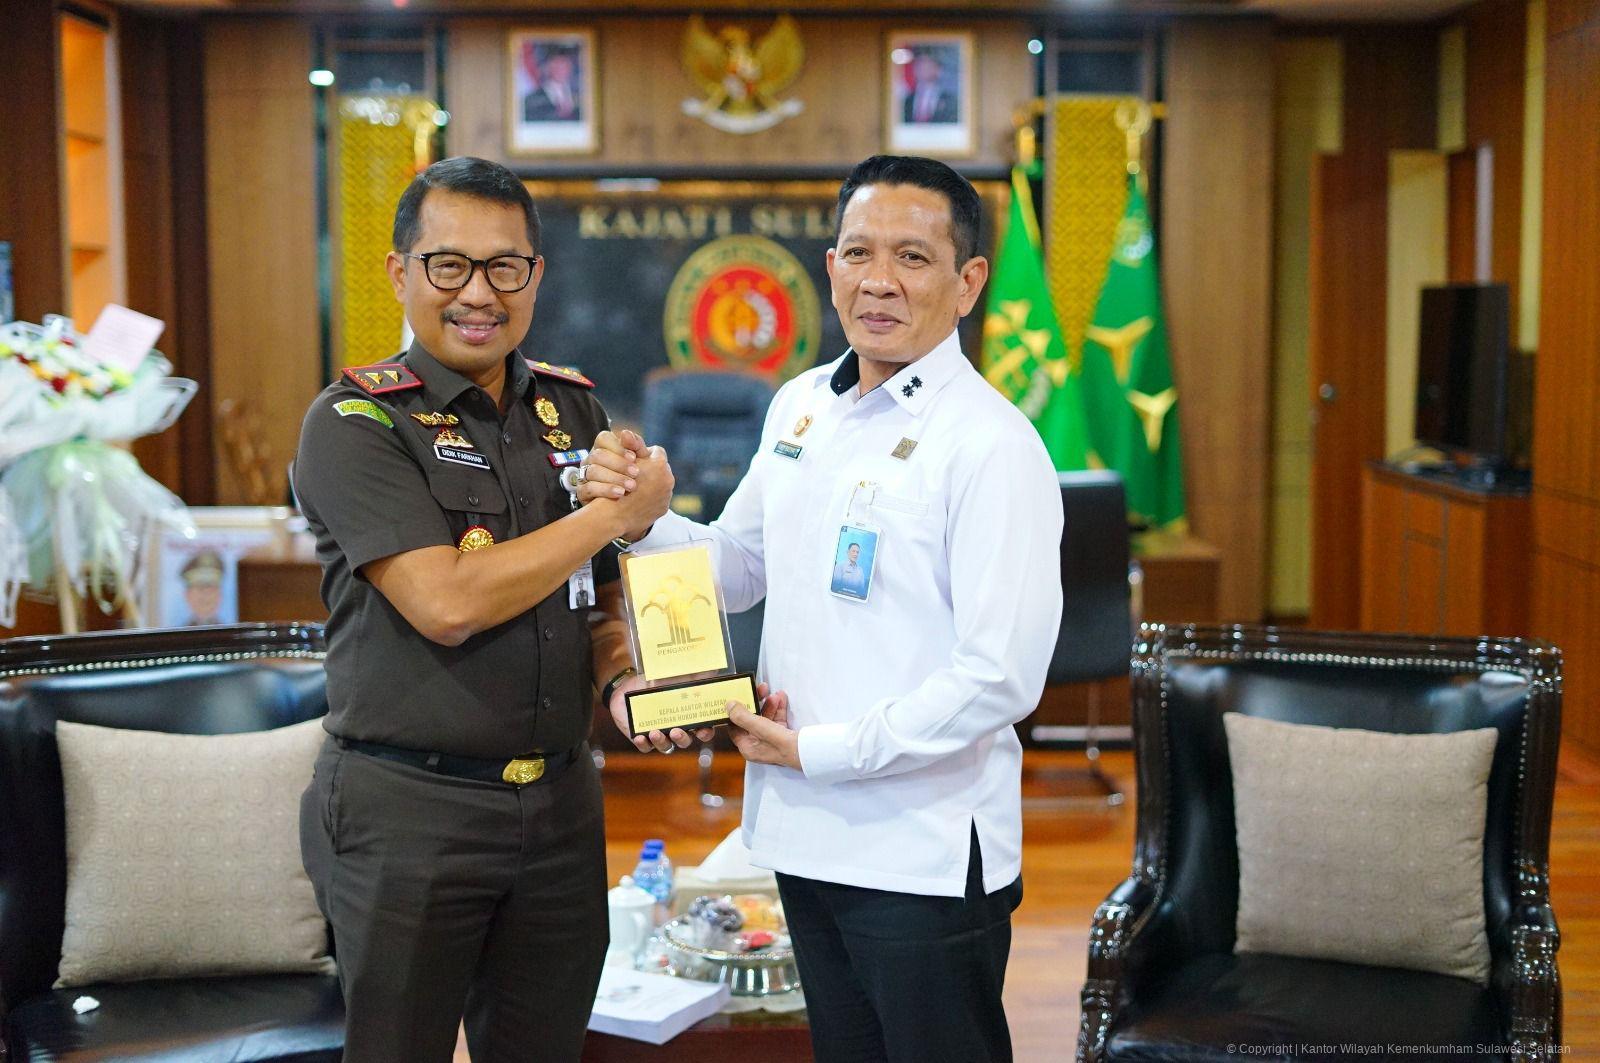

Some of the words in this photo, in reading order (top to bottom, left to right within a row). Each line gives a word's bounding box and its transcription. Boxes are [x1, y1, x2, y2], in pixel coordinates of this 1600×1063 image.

[578, 205, 732, 239] KAJATI
[752, 205, 836, 239] SUL
[441, 449, 457, 458] DIDIK
[456, 452, 483, 463] FARKHAN
[658, 706, 680, 716] KEPALA
[680, 702, 702, 712] KANTOR
[639, 716, 677, 727] KEMENTERIAN
[677, 712, 698, 721] HUKUM
